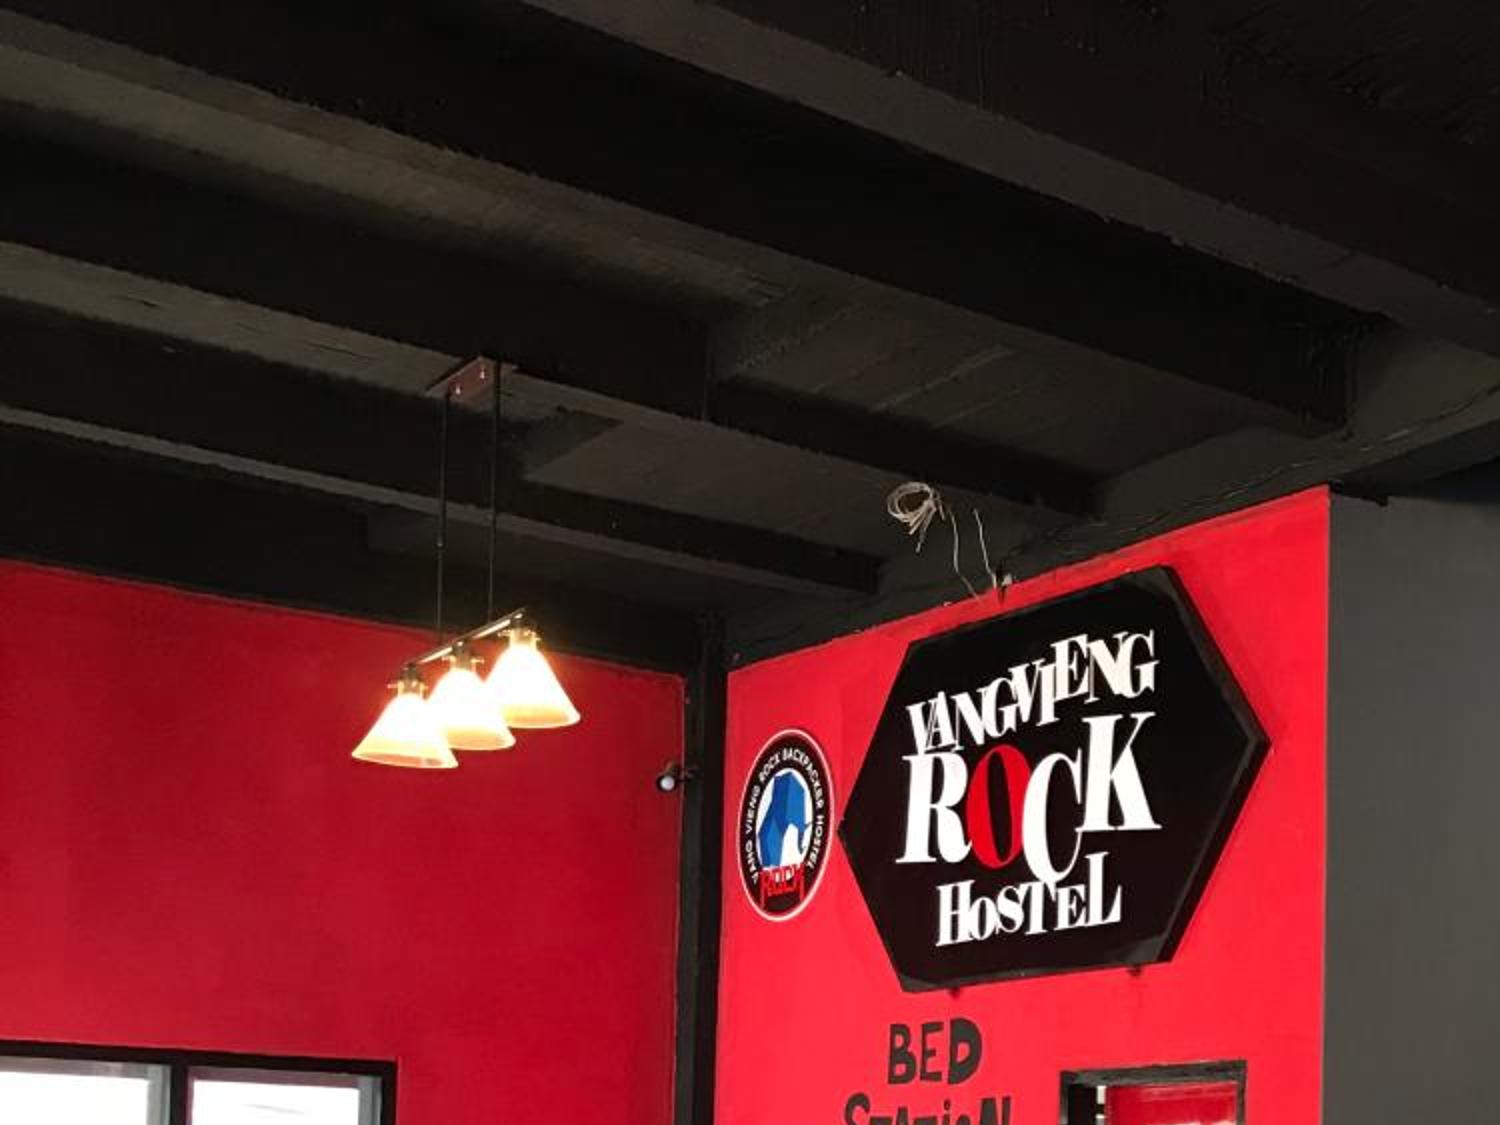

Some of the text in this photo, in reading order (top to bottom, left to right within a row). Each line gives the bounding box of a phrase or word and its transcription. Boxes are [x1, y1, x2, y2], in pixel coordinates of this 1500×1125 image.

[758, 752, 781, 783] ROCK
[895, 711, 1163, 892] ROCK
[887, 1016, 983, 1085] BED
